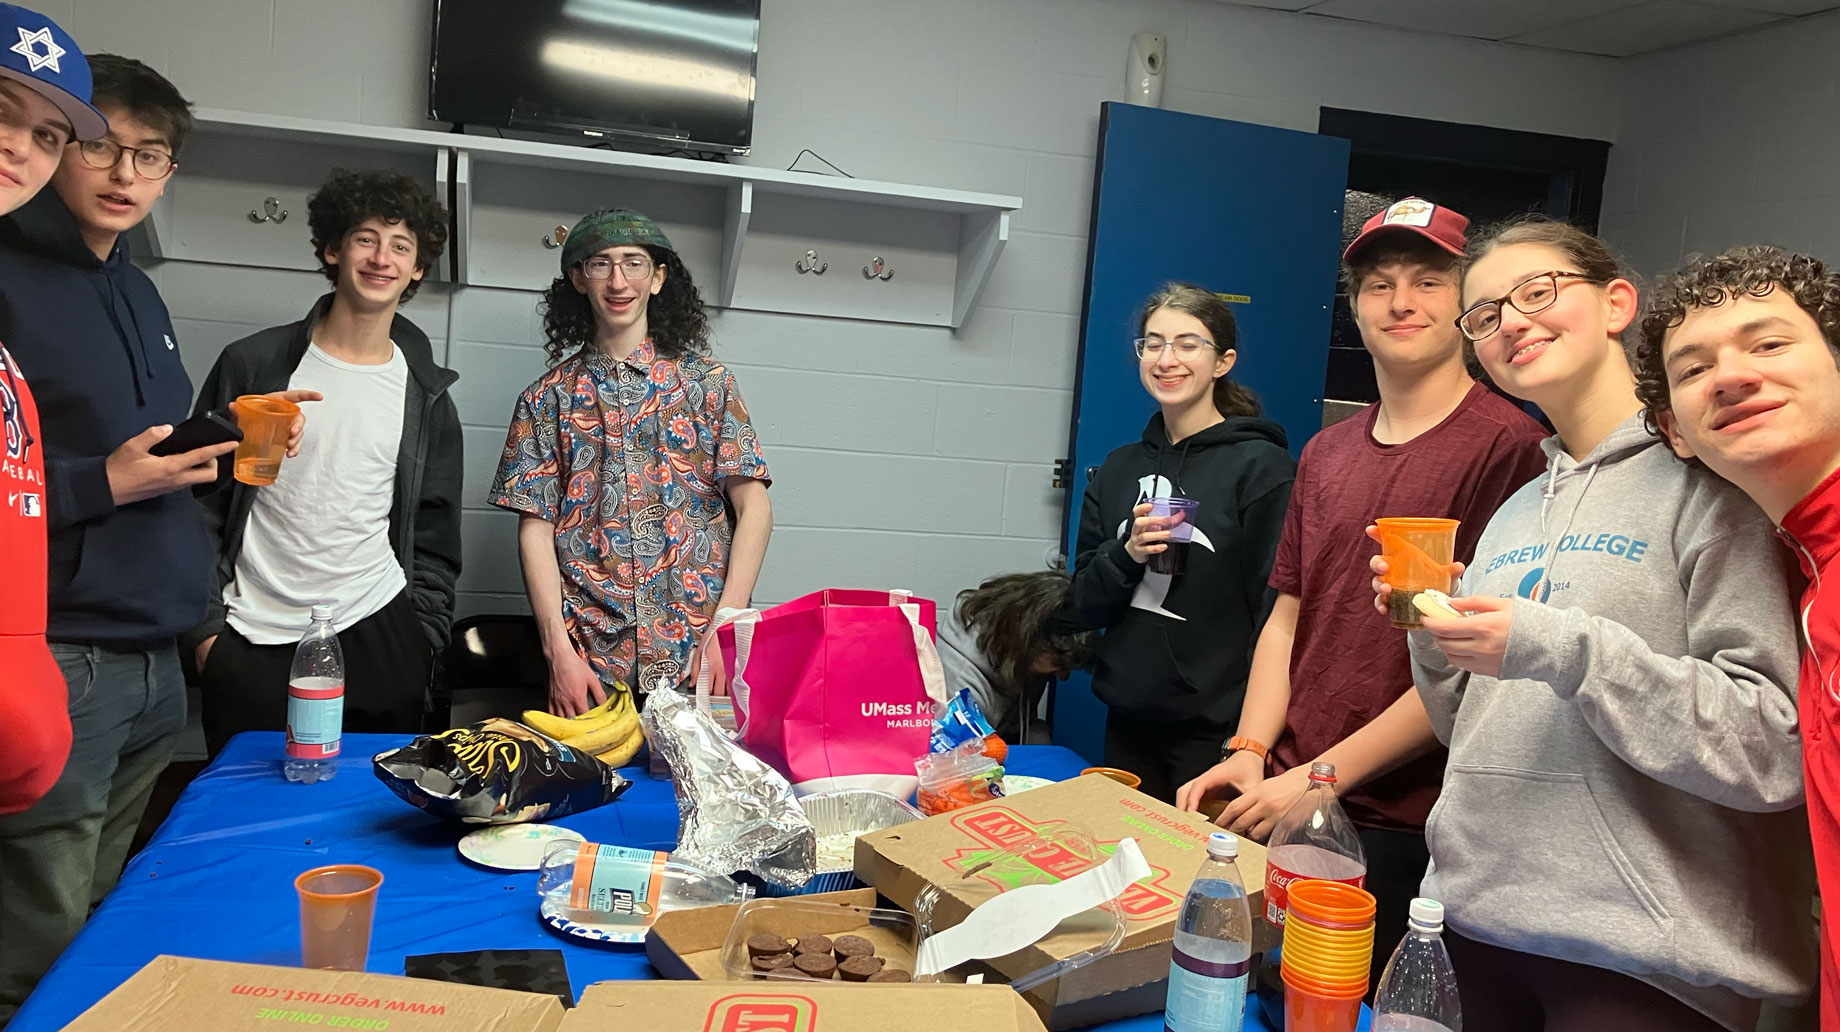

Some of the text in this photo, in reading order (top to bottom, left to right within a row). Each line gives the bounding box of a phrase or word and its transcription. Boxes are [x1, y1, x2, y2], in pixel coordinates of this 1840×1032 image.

[1485, 533, 1649, 575] EBREW OLLEGE
[1552, 581, 1571, 593] 2014
[861, 702, 912, 717] UMass
[1156, 831, 1195, 851] ORDER
[231, 984, 446, 1015] www.vegcrust.com
[256, 1007, 390, 1031] ORDER ONLINE
